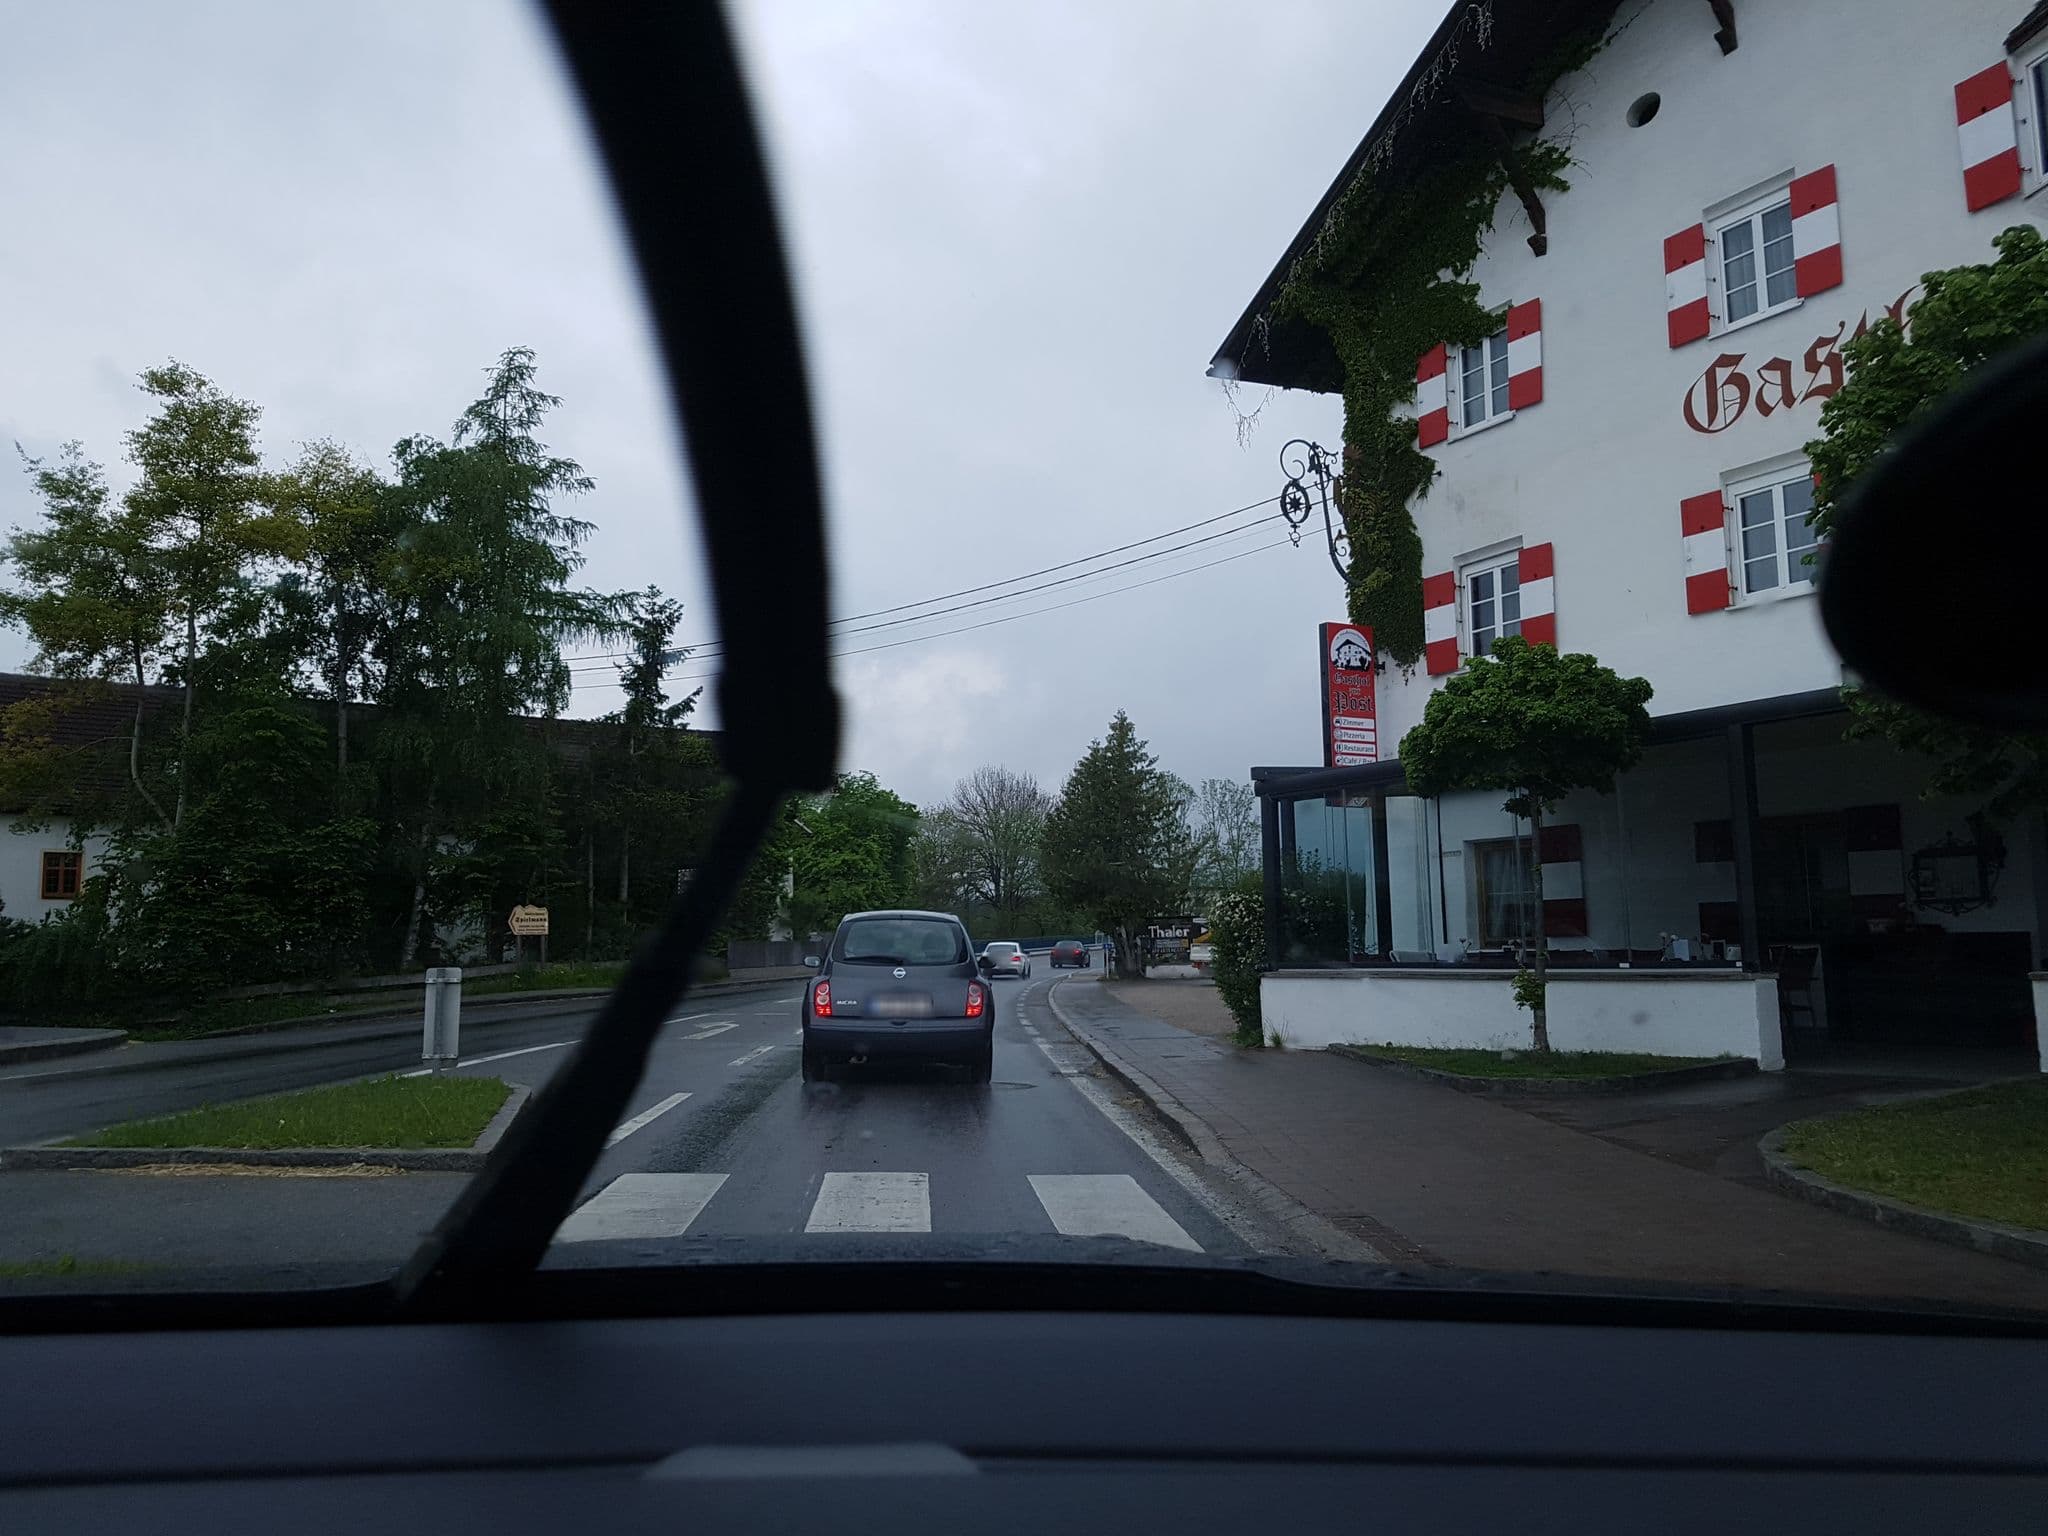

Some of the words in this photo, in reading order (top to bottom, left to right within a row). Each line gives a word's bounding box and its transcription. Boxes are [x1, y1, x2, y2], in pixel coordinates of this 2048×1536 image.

[1334, 691, 1374, 713] Post
[1342, 719, 1364, 727] Zimmer
[1343, 731, 1366, 740] Pizzeria
[1343, 744, 1374, 752] Restaurant
[1147, 925, 1190, 938] Thaler
